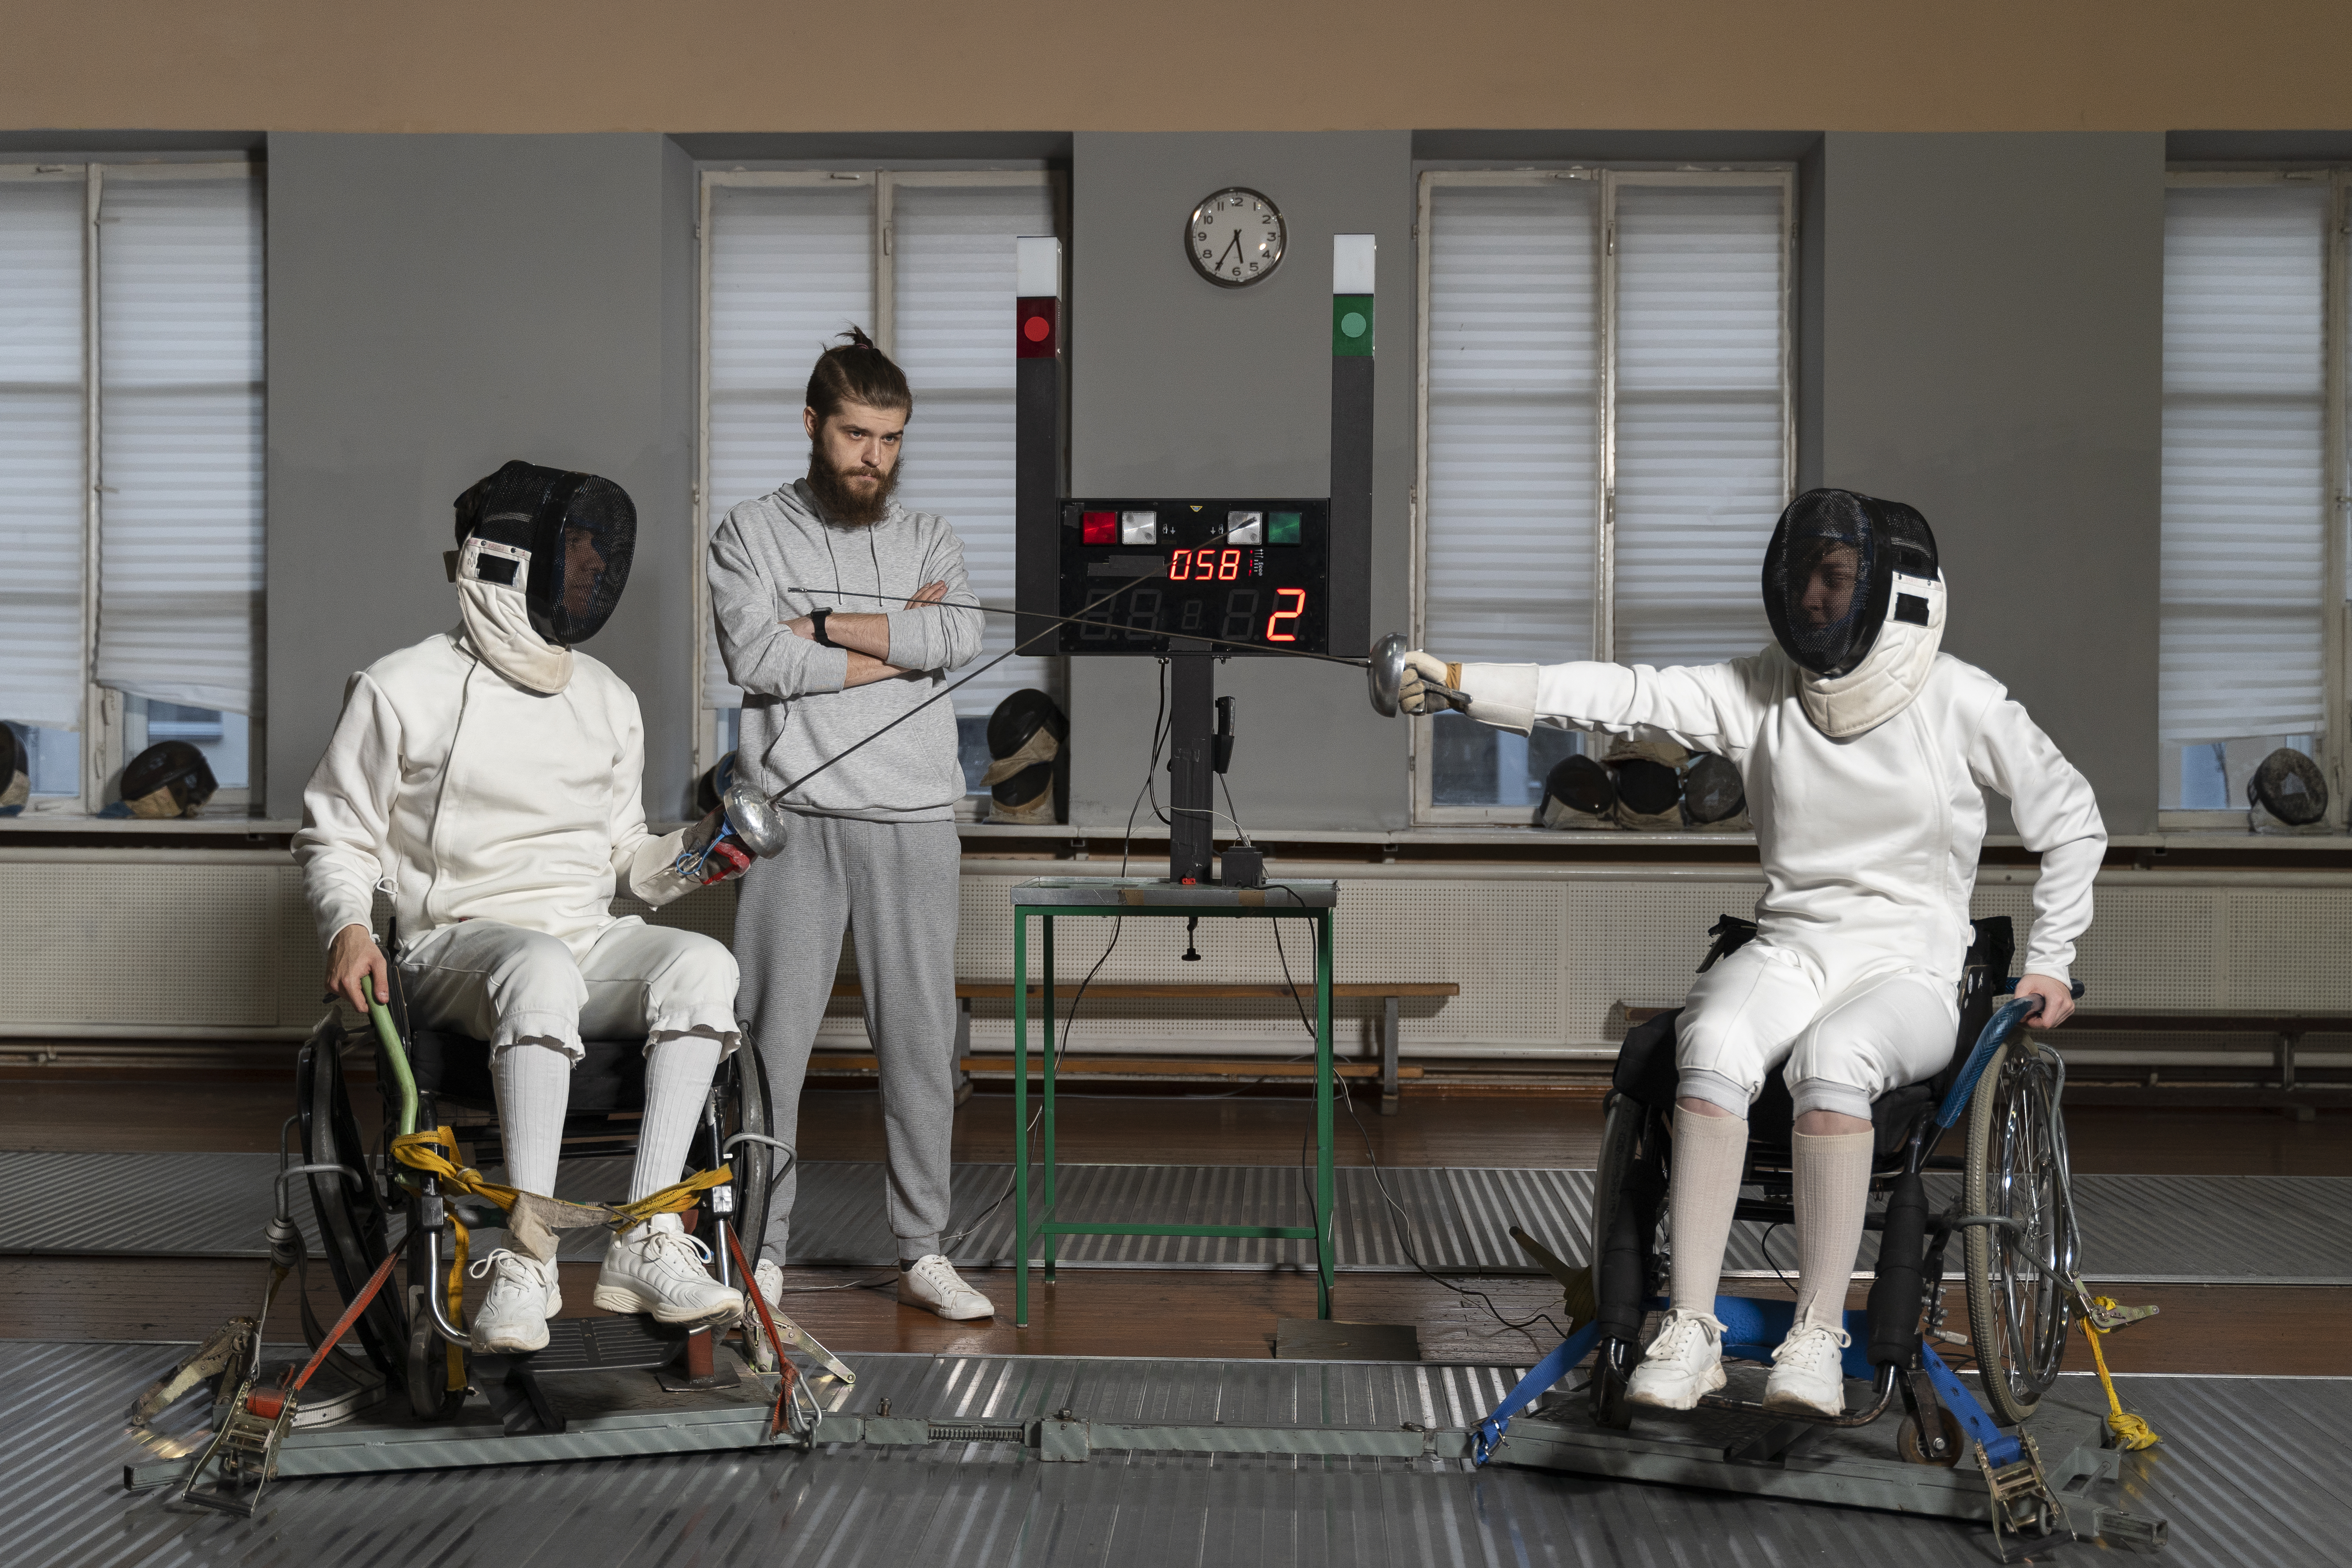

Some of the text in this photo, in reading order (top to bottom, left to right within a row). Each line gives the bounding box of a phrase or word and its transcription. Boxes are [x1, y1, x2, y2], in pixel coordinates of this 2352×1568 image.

[1218, 202, 1224, 211] 11
[1232, 198, 1243, 207] 12
[1204, 216, 1213, 225] 10
[1262, 215, 1271, 224] 2
[1198, 232, 1207, 241] 9
[1267, 232, 1276, 242] 3
[1203, 250, 1213, 259] 8
[1262, 250, 1271, 259] 4
[1250, 262, 1259, 271] 5
[1232, 267, 1241, 276] 6
[1267, 588, 1306, 642] 2
